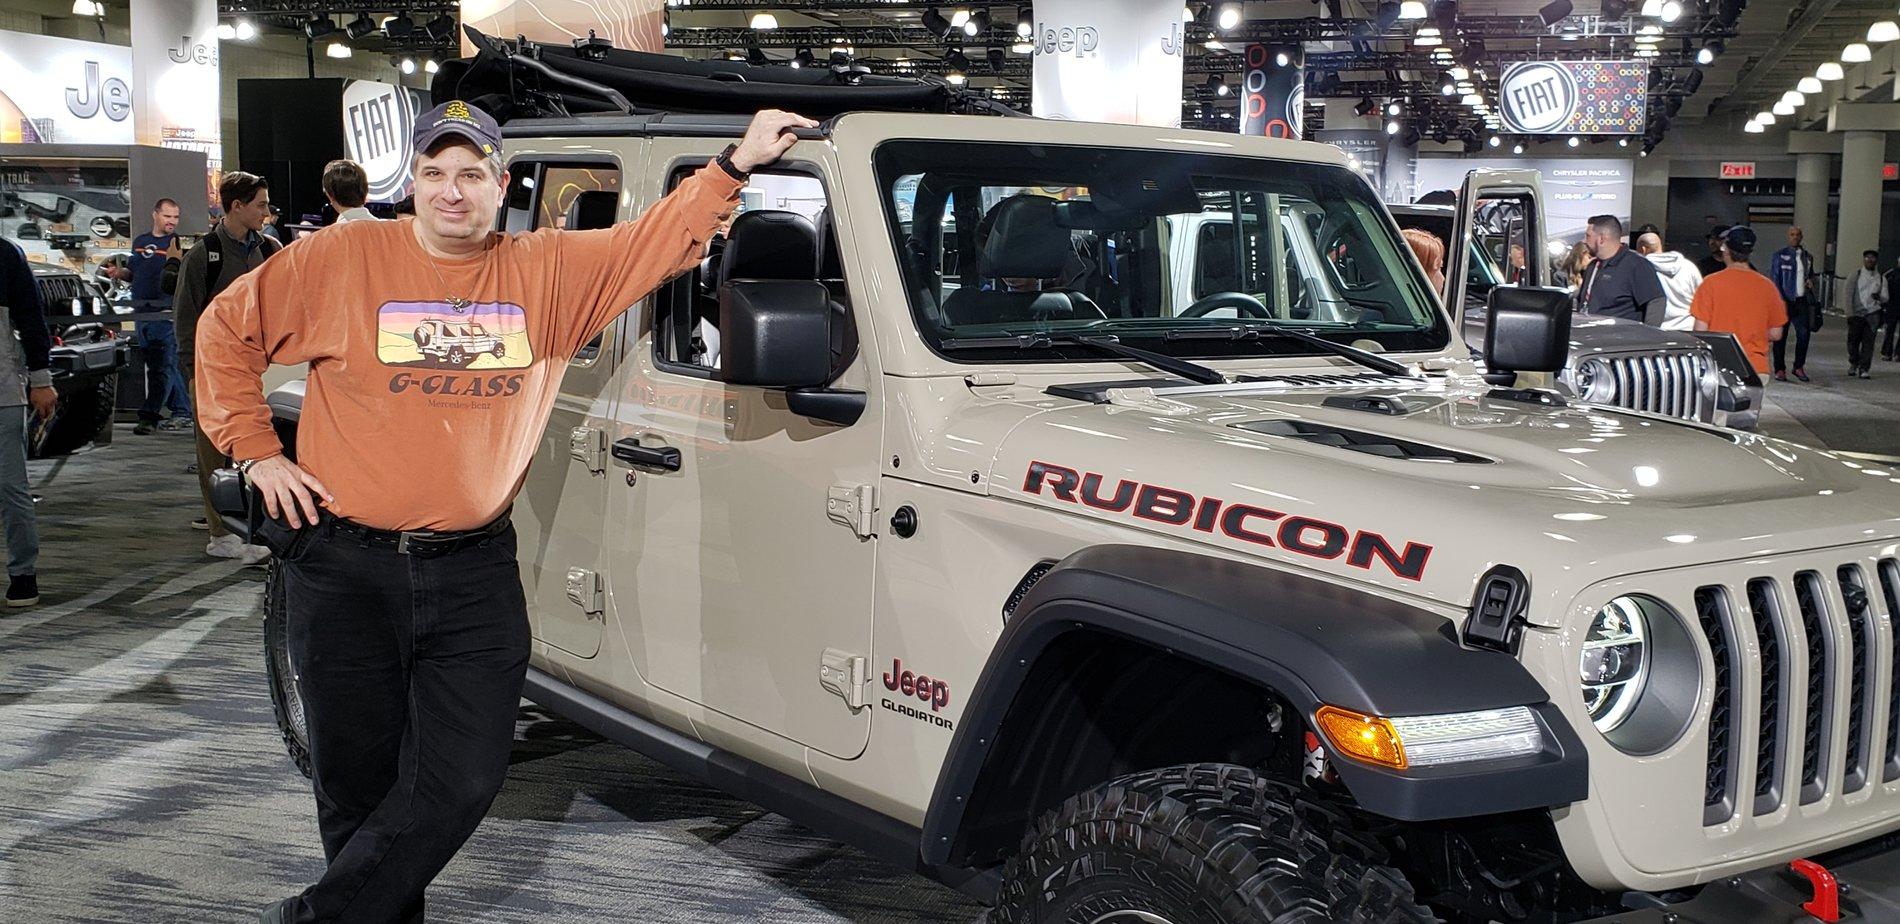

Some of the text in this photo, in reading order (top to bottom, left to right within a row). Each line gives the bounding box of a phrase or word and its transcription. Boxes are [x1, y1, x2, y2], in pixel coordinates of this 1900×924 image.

[1034, 23, 1099, 58] Jeep
[65, 61, 135, 122] Je
[1513, 76, 1559, 120] FIAT
[348, 93, 398, 164] FIAT
[389, 373, 525, 397] G-CLASS
[427, 400, 492, 409] Mercedes-Benz
[1022, 460, 1433, 582] RUBICON
[882, 657, 950, 712] Jeep
[881, 698, 953, 731] GLADIATOR
